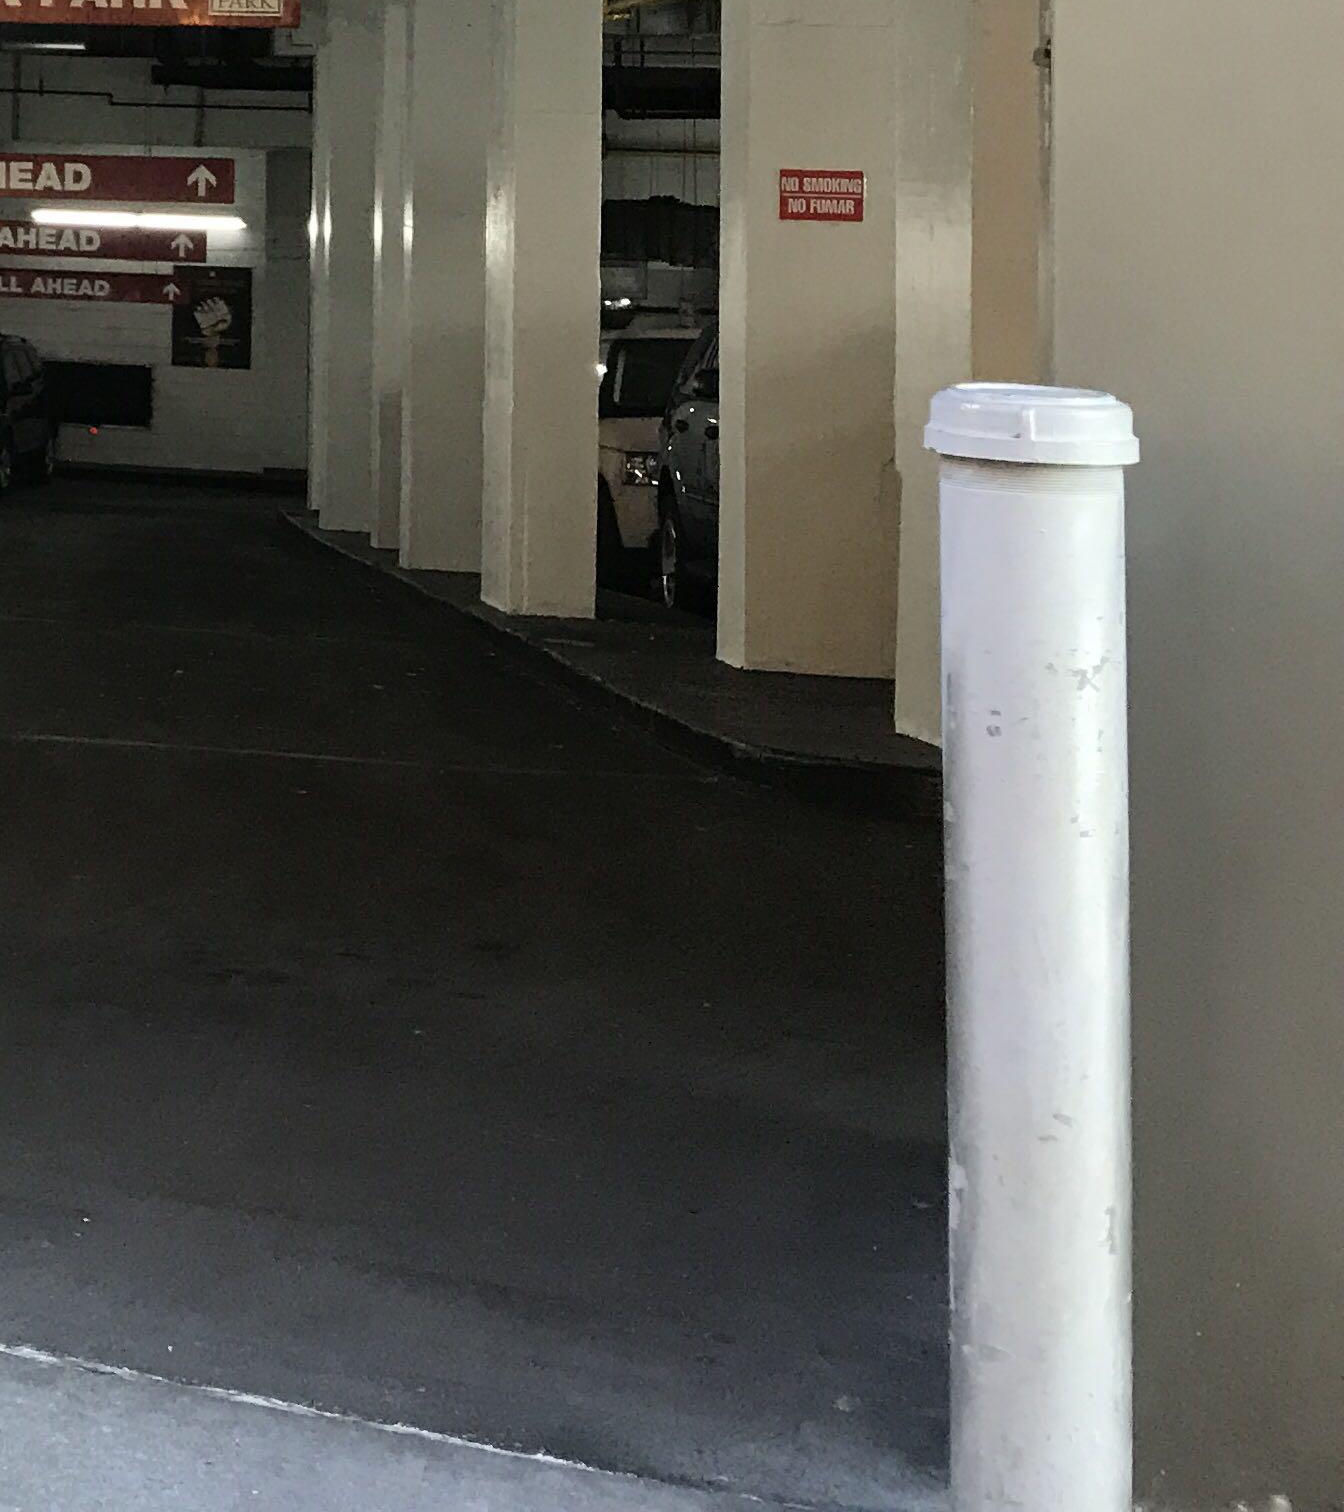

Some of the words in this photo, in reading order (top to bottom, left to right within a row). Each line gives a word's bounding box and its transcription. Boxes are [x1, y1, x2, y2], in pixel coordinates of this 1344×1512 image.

[781, 177, 799, 192] NO
[803, 177, 861, 194] SMOKING
[788, 198, 806, 214] NO
[810, 199, 855, 215] FUMAR
[30, 277, 111, 296] AHEAD
